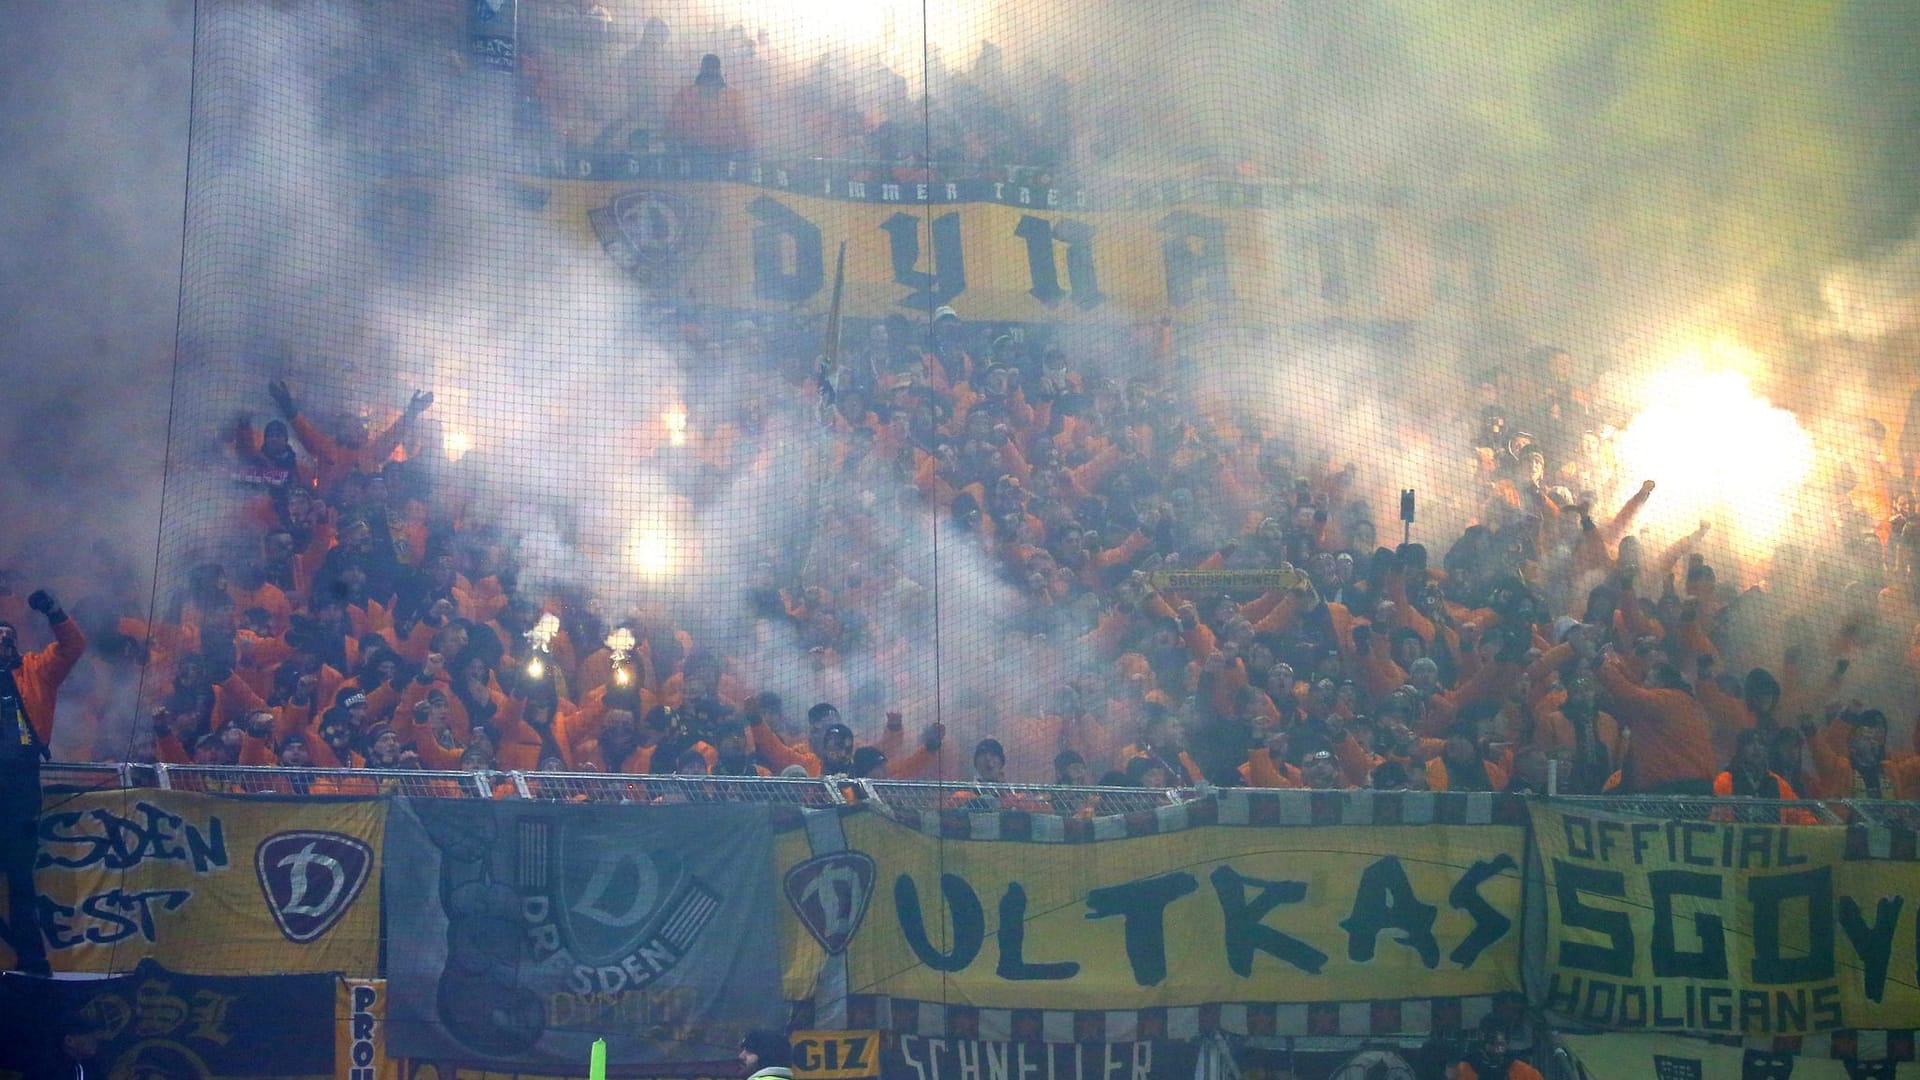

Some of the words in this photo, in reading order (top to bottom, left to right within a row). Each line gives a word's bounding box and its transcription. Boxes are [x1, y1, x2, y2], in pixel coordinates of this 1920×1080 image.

[824, 179, 958, 201] IMMER
[36, 802, 228, 873] SDEN
[1562, 814, 1808, 869] OFFICIAL
[893, 853, 1517, 988] ULTRAS
[1548, 973, 1843, 1033] HOOLIGANS
